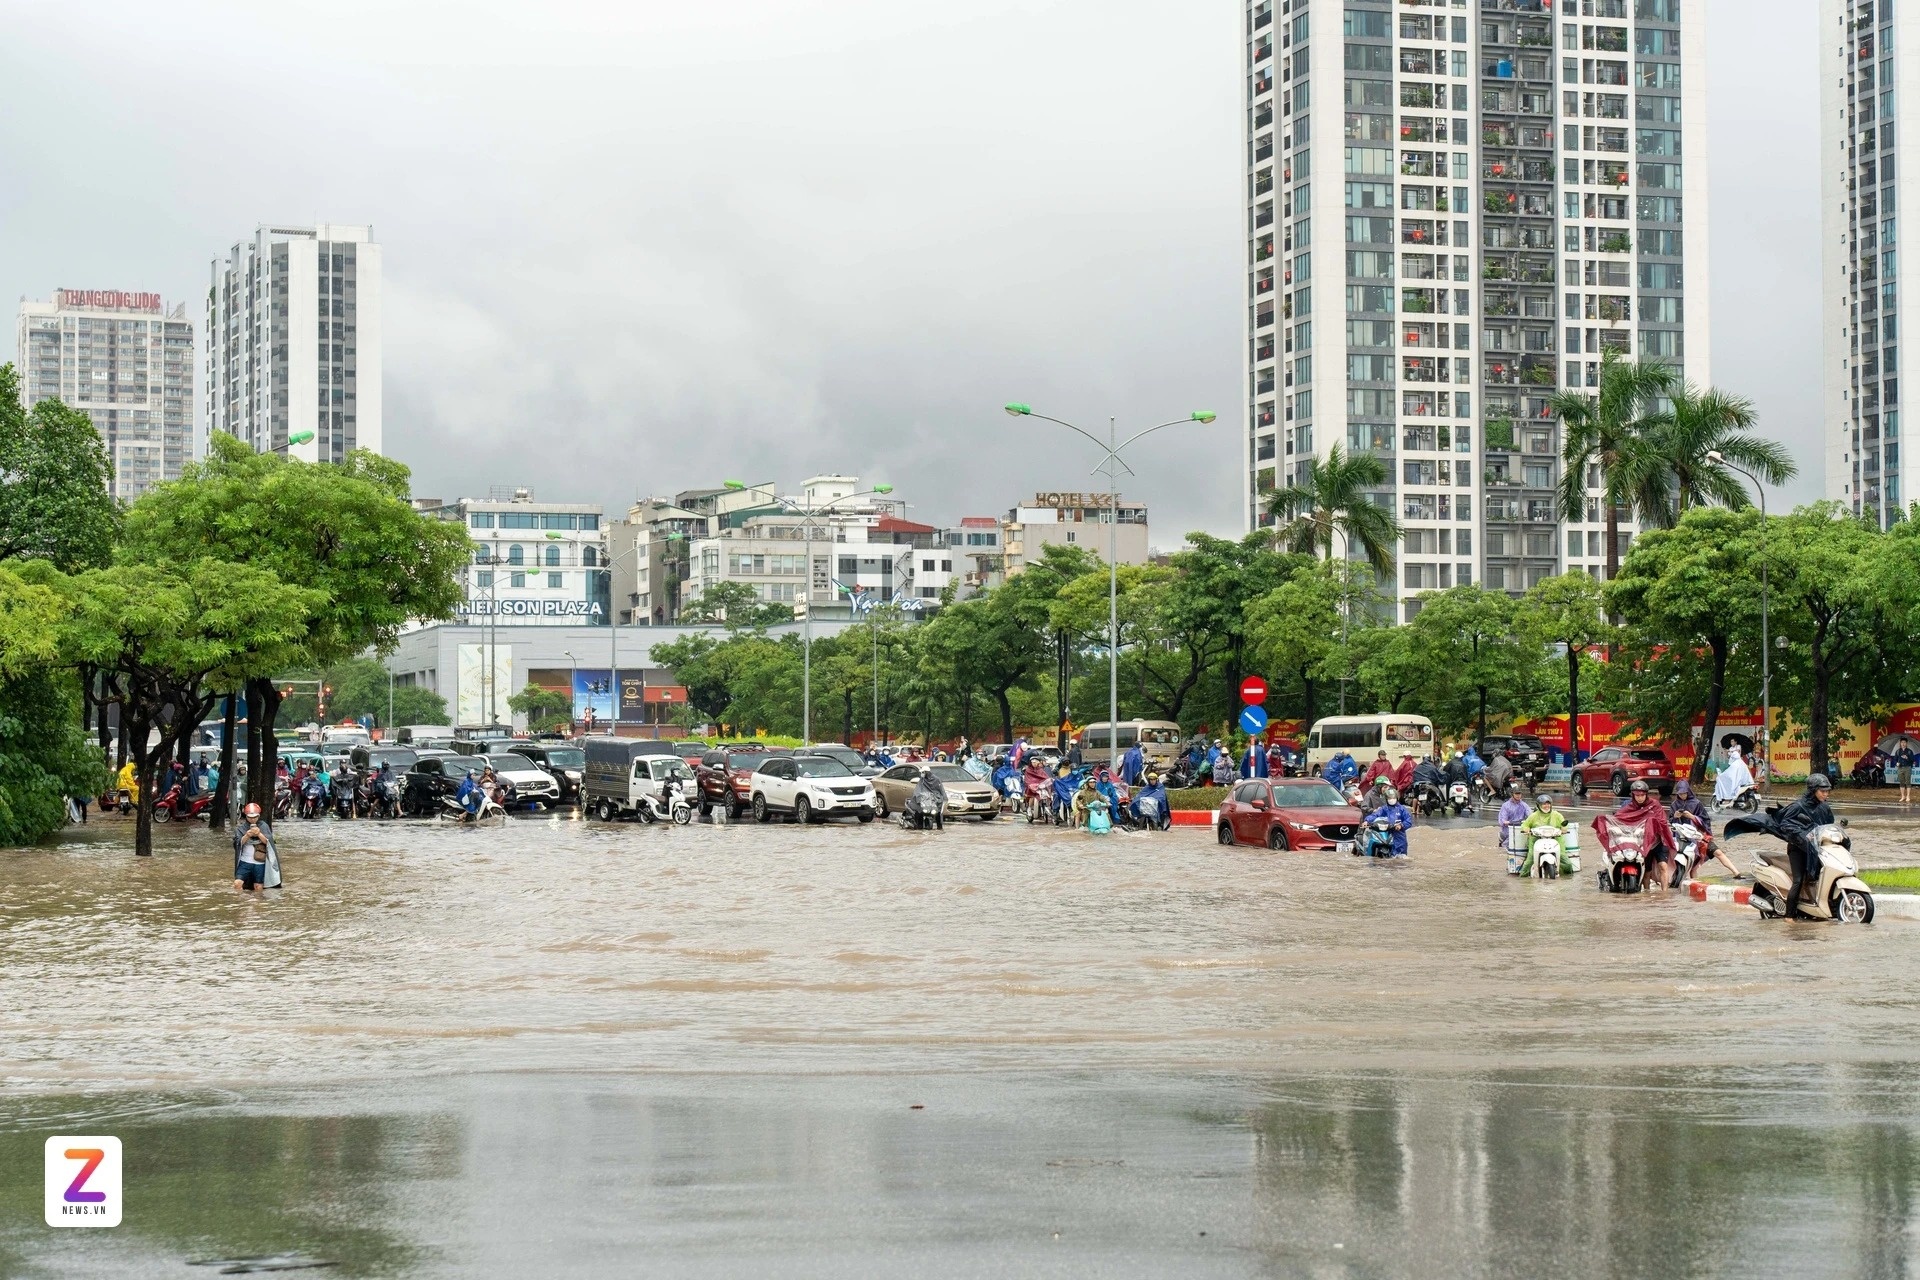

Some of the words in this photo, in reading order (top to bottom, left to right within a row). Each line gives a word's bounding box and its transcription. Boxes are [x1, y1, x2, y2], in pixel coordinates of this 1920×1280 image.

[1036, 492, 1085, 507] HOTEL
[455, 600, 500, 615] HIEN
[501, 600, 541, 615] SON
[544, 600, 603, 615] PLAZA
